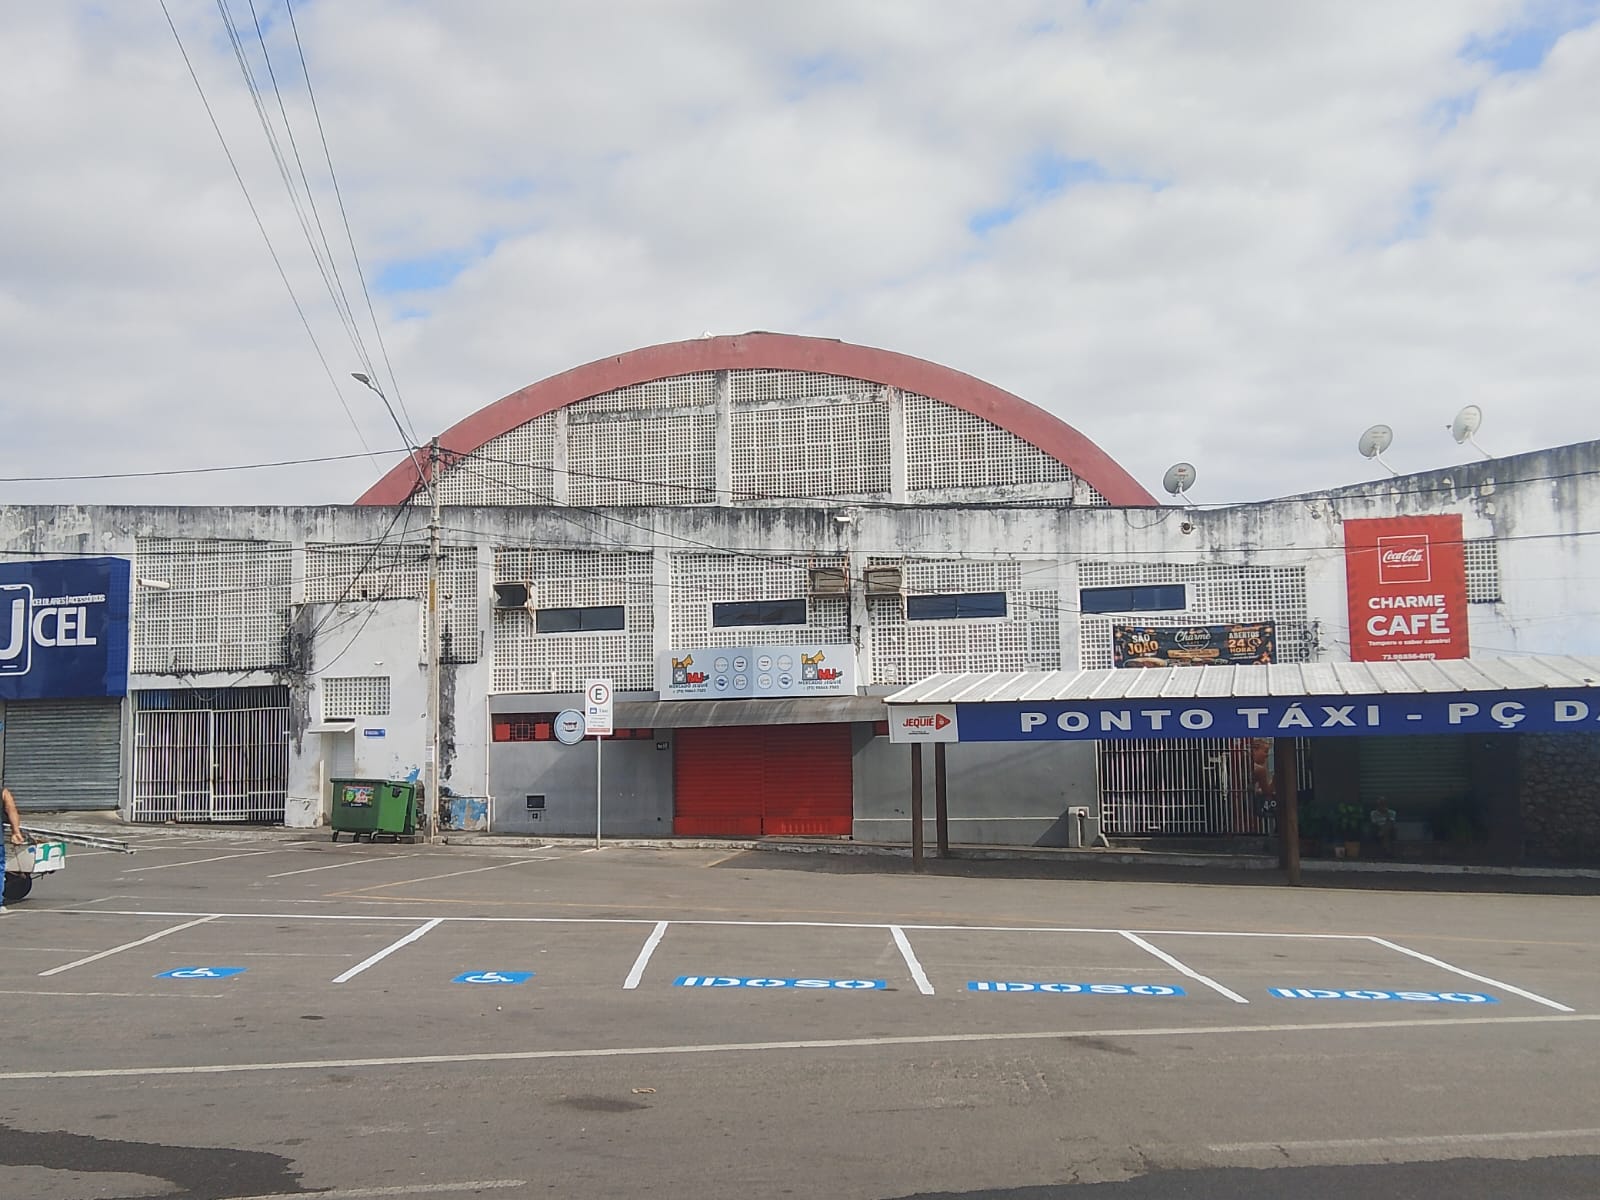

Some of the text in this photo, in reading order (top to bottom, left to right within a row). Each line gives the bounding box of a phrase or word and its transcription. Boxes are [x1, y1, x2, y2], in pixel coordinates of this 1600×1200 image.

[1368, 594, 1446, 609] CHARME
[1366, 607, 1451, 636] CAFÉ
[1174, 630, 1212, 643] Charme
[1228, 631, 1260, 639] ABERTOS
[1228, 639, 1246, 648] 24
[595, 688, 603, 700] E
[903, 717, 934, 728] JEQUIÉ
[1020, 709, 1214, 733] PONTO
[1237, 702, 1381, 729] TÁXI
[1448, 701, 1527, 729] PÇ
[683, 976, 876, 989] IDOSO
[978, 982, 1174, 995] IDOSO
[1276, 988, 1487, 1002] IDOSO
